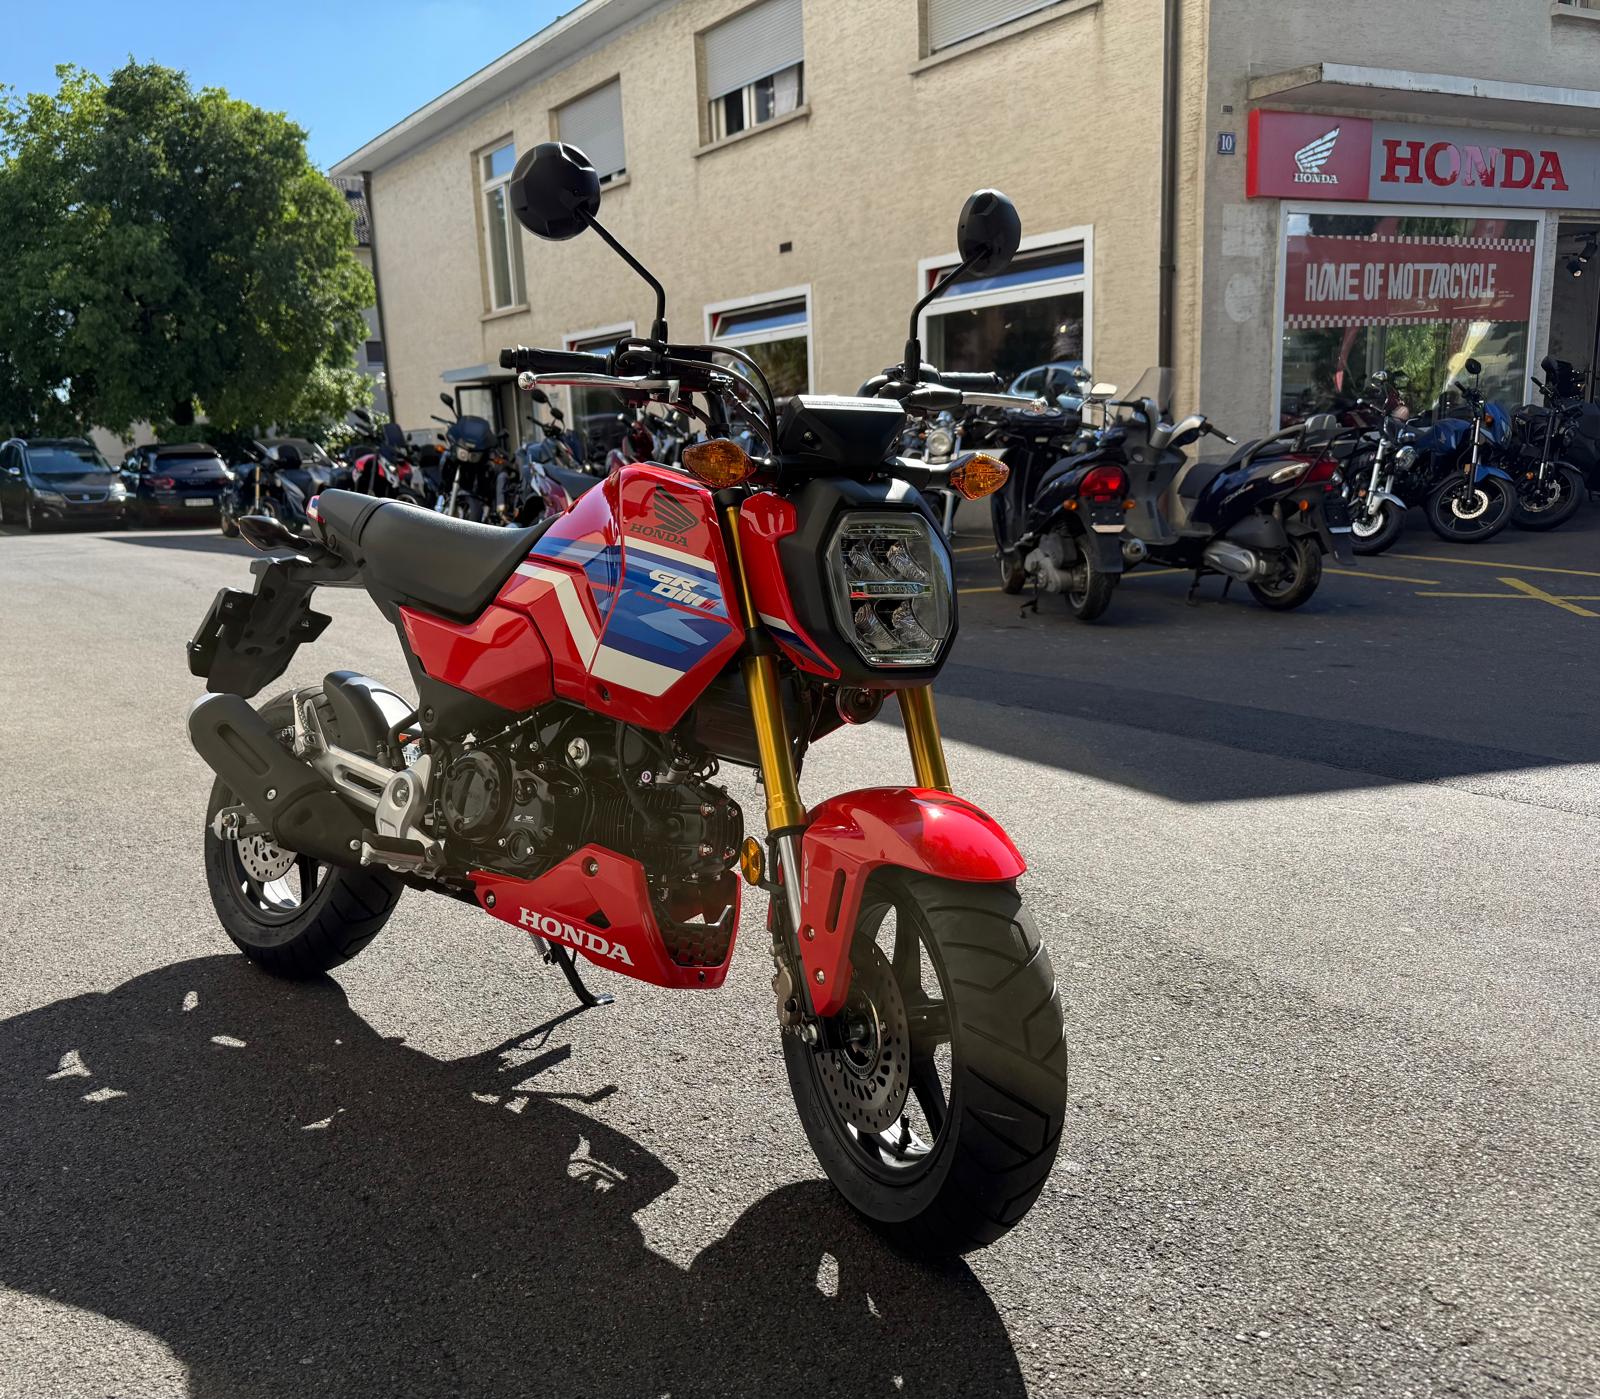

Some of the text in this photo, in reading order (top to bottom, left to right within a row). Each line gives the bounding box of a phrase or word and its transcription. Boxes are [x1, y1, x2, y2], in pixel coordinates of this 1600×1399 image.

[1221, 135, 1233, 151] 10
[1294, 173, 1339, 184] HONDA
[1380, 139, 1569, 191] HONDA
[1305, 262, 1497, 301] HOME OF MOTORCYCLE
[629, 523, 689, 547] HONDA
[518, 906, 635, 967] HONDA
